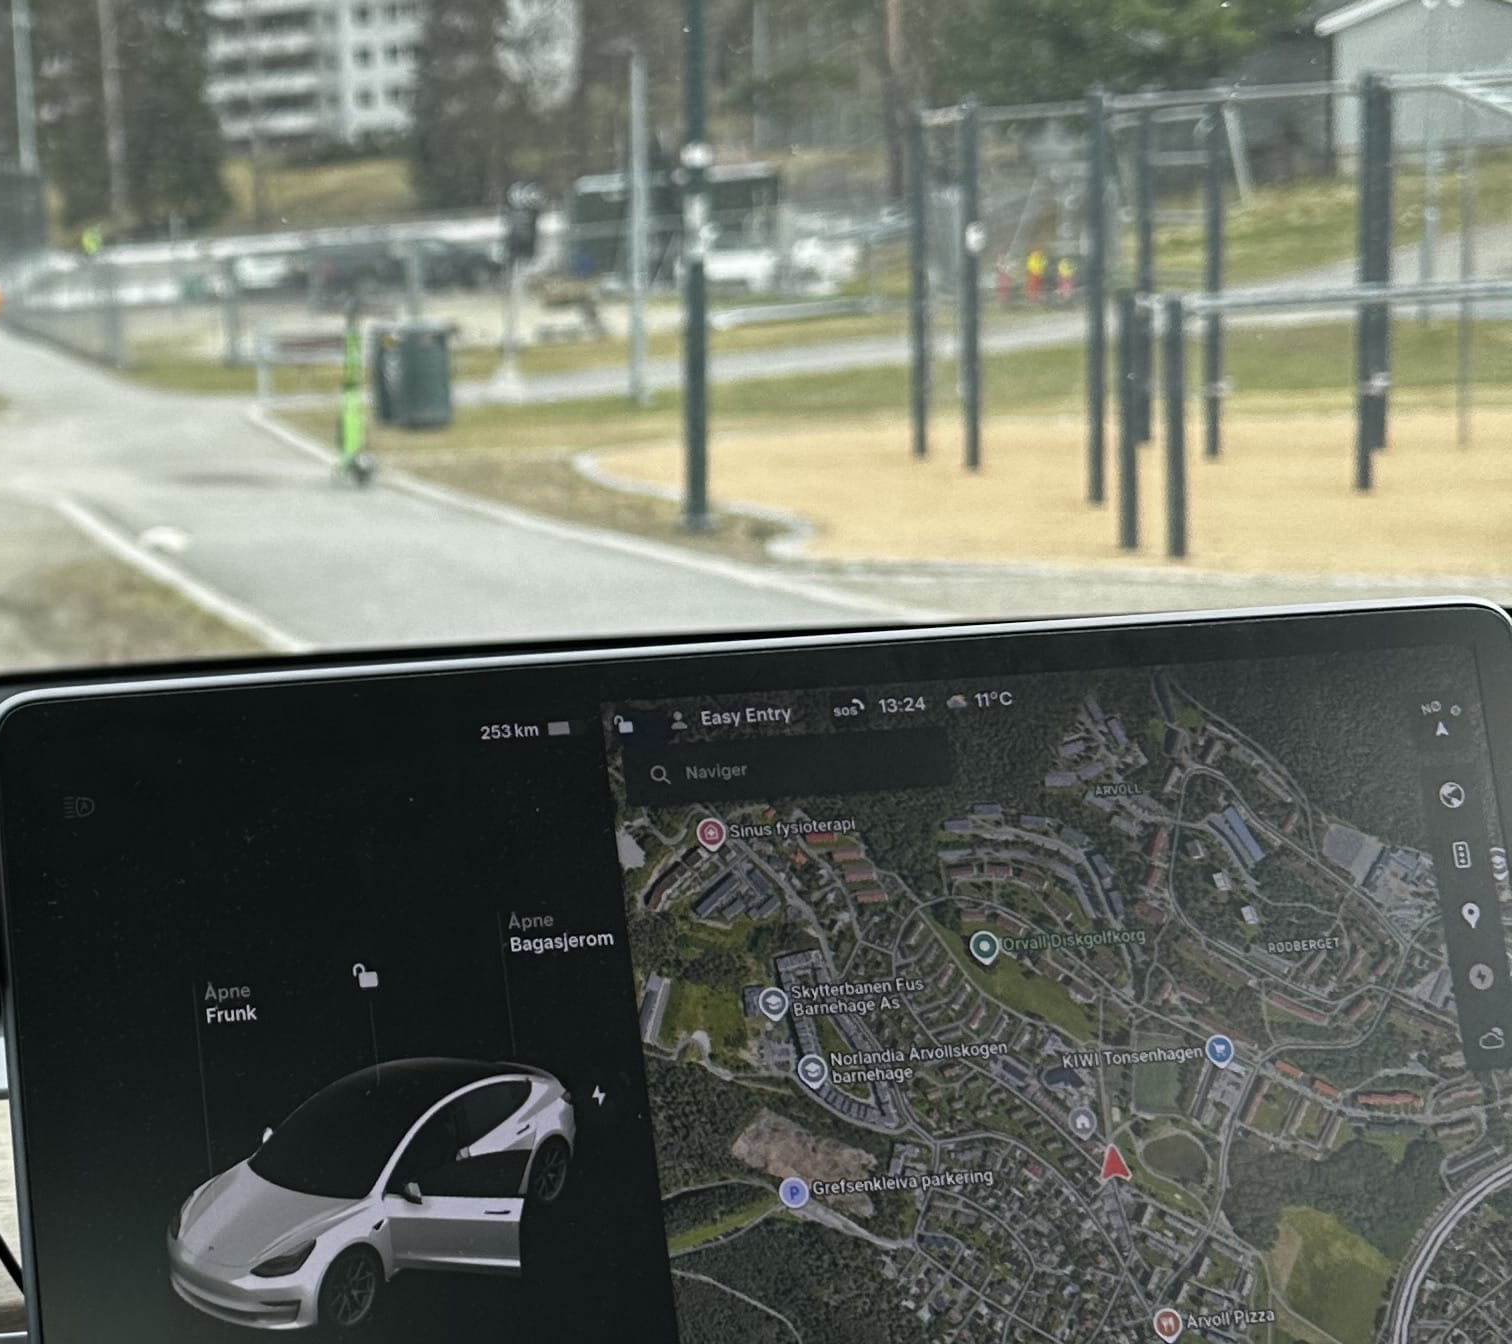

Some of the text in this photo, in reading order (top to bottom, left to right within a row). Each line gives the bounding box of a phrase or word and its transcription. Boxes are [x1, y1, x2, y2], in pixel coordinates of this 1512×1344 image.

[878, 697, 926, 714] 13:24
[974, 691, 1013, 709] 11°C
[701, 706, 792, 728] Easy Entry
[480, 722, 539, 740] 253 km
[686, 763, 748, 782] Naviger
[730, 817, 856, 839] Sinus fysioterapi
[509, 929, 614, 954] Bagasjerom
[1050, 928, 1147, 950] Diskgolfkorg
[791, 976, 924, 1000] Skytterbanen Fus
[205, 1004, 258, 1023] Frunk
[793, 994, 901, 1018] Barnehage As
[830, 1049, 904, 1067] Norlandia
[1062, 1046, 1204, 1069] KIWI Tonsenhagen
[832, 1065, 913, 1085] barnehage
[812, 1170, 994, 1195] Grefsenkleiva parkering
[1234, 1310, 1275, 1324] Pizza
